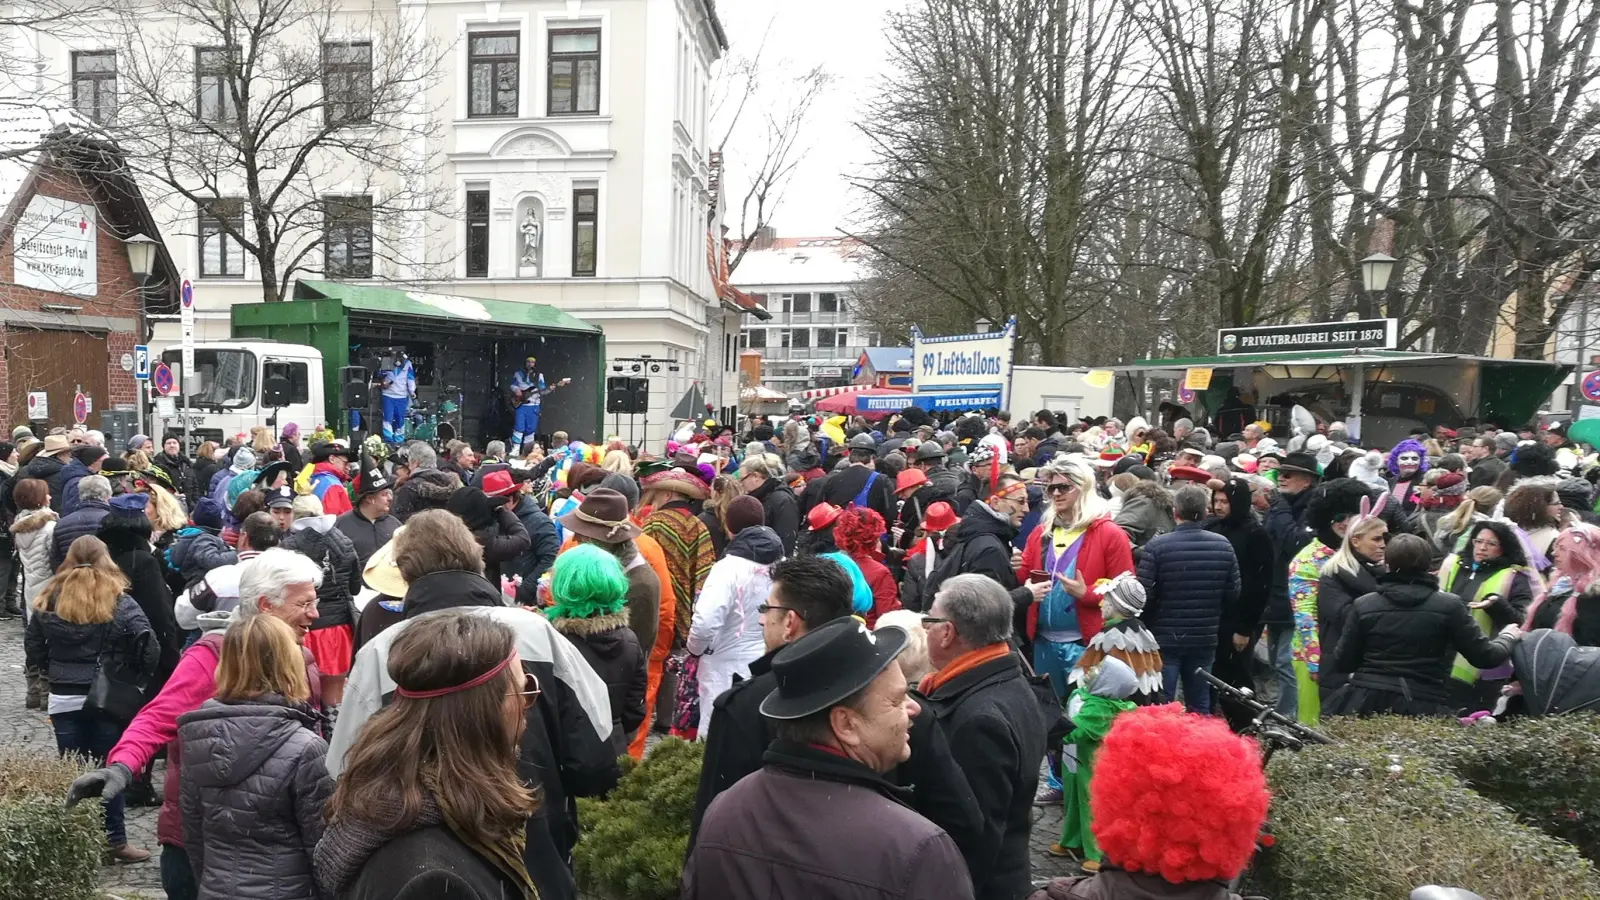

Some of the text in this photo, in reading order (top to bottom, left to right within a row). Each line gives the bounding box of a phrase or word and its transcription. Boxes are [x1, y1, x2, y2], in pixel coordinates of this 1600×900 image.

[1241, 328, 1383, 347] PRIVATBRAUEREI SEIT 1878
[922, 350, 1001, 376] 99 Luftballons
[867, 397, 998, 409] PFEILWERFEN PFEILWERFEN
[176, 413, 206, 429] Aynger
